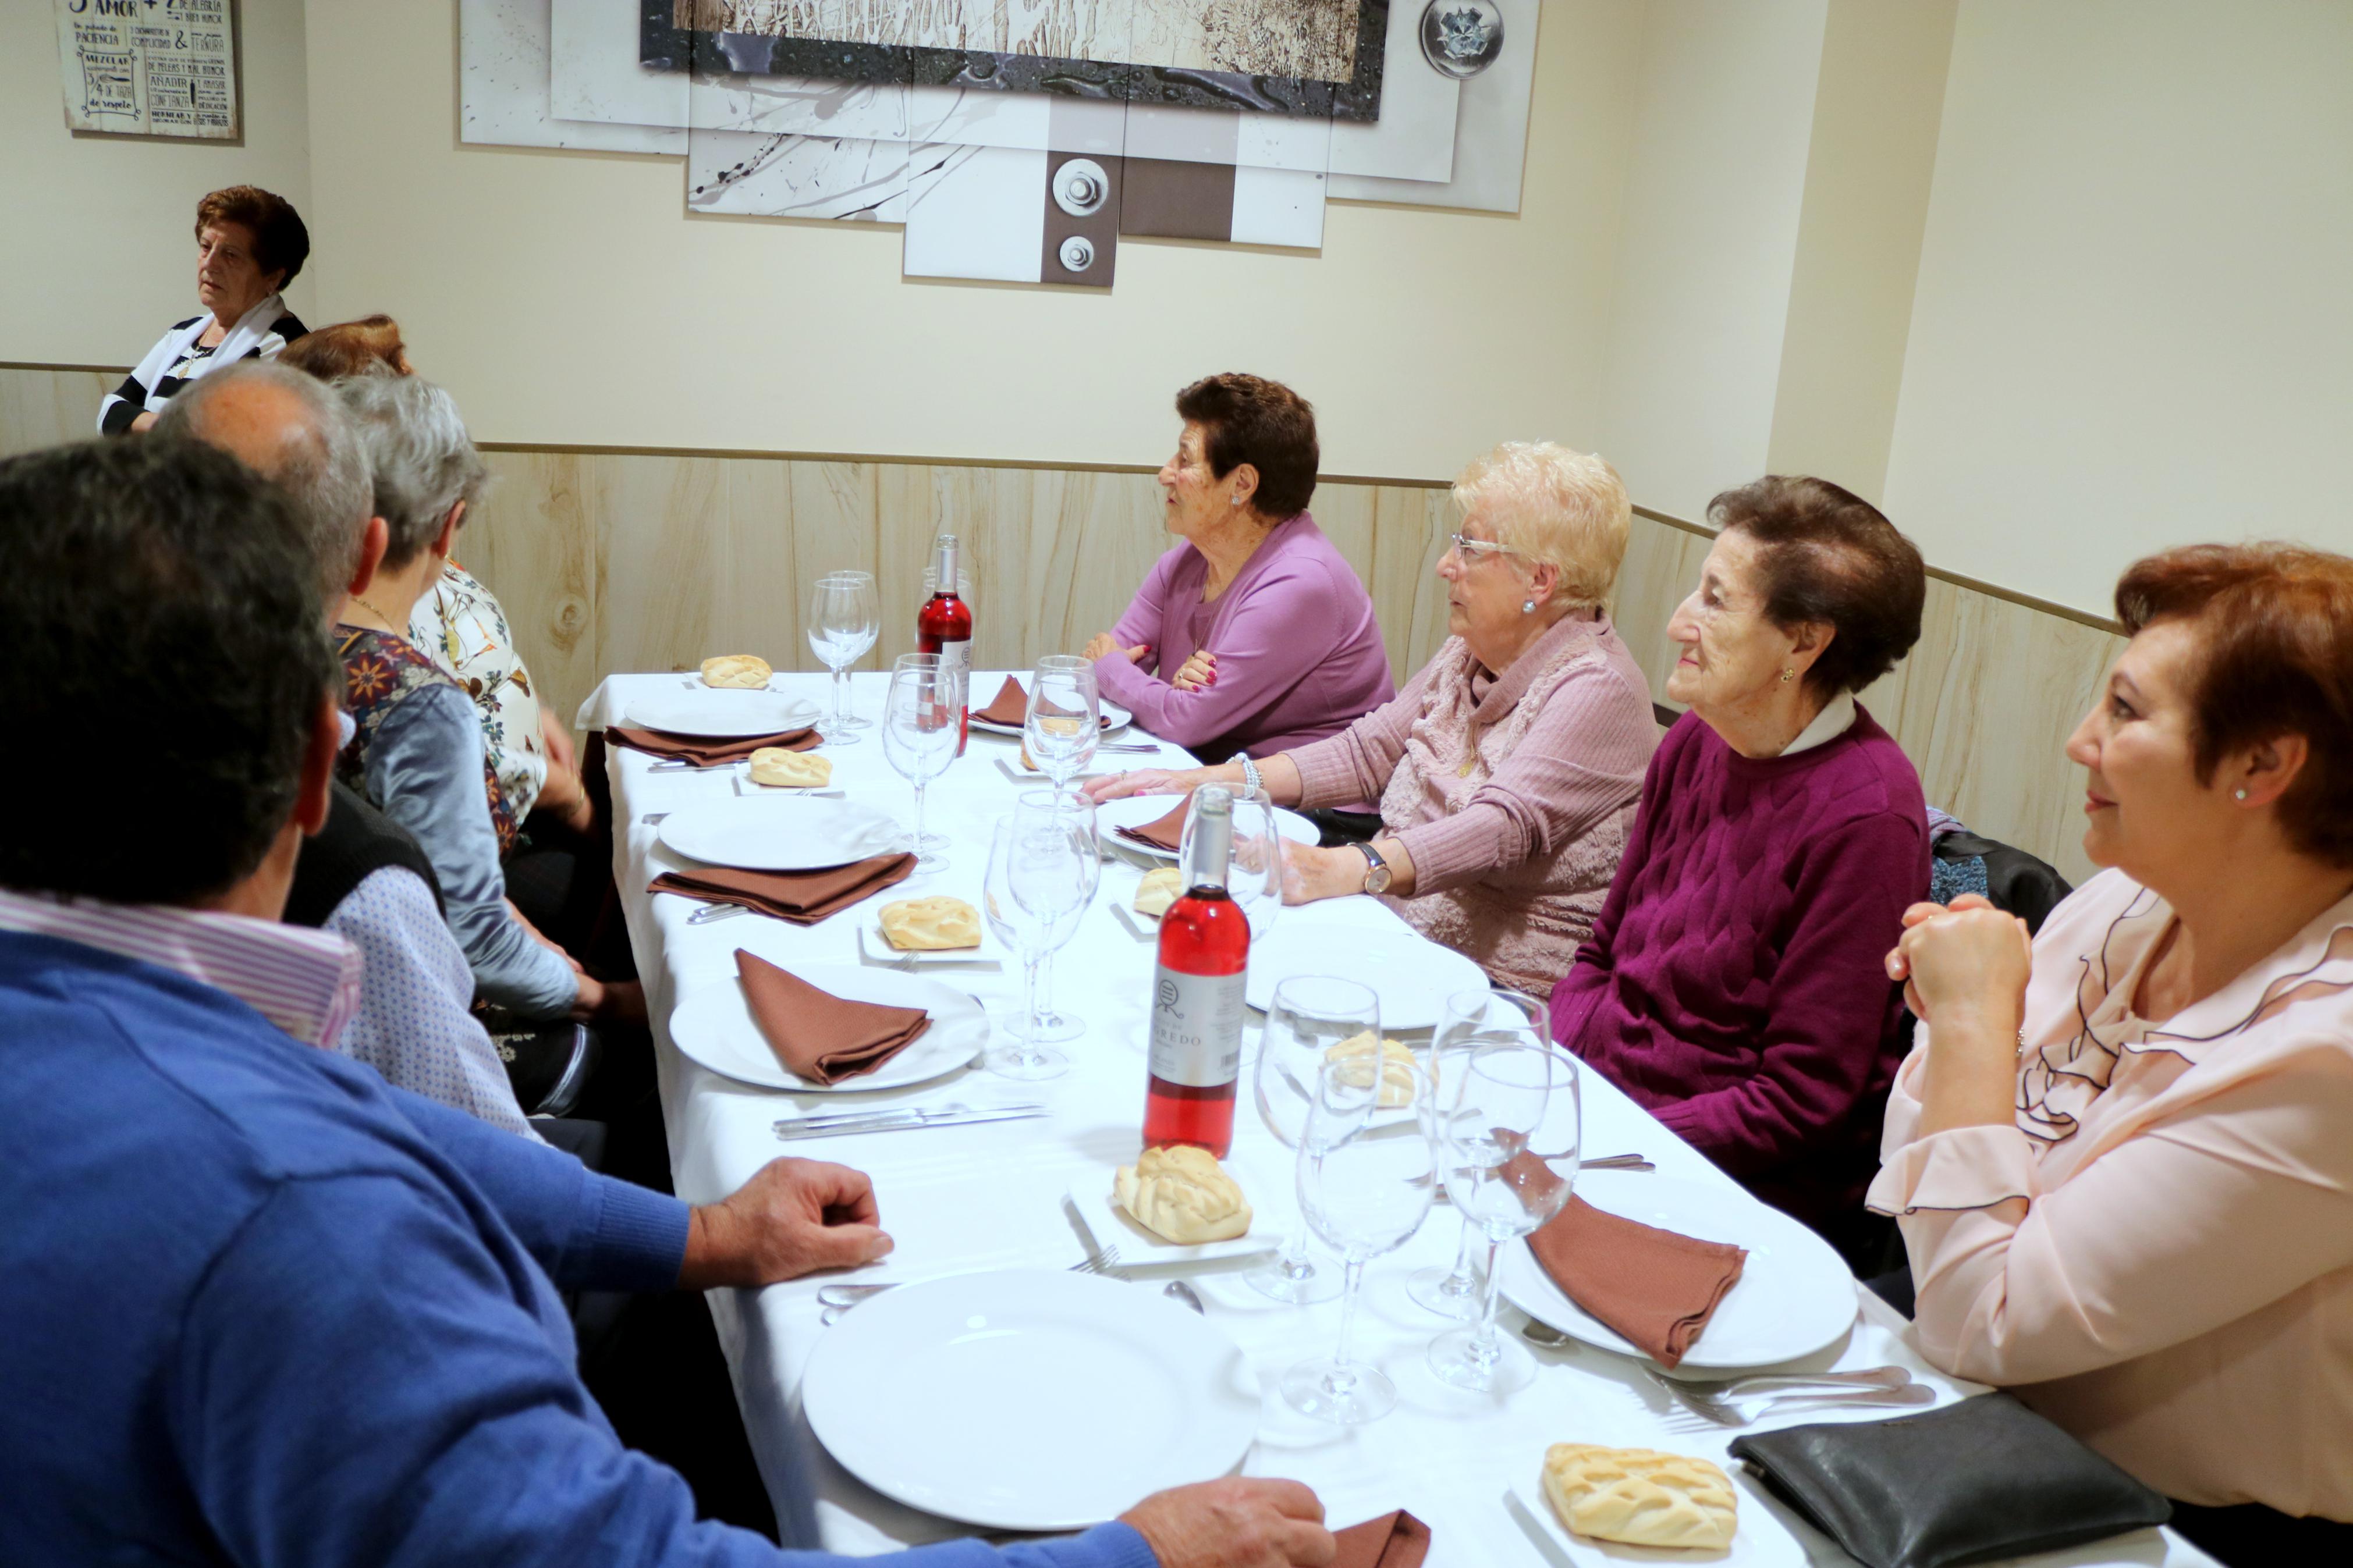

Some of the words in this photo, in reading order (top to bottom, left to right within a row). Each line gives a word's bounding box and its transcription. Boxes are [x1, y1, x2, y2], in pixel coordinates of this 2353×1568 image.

[75, 32, 119, 45] PACIENCIA
[191, 37, 225, 52] TERNURA
[86, 54, 130, 65] MEZCLAR
[158, 62, 180, 73] PELEAS
[203, 65, 226, 76] HUMOR
[150, 74, 188, 88] AÑADIR
[203, 79, 226, 89] AMASAR
[116, 85, 132, 98] TAZA
[90, 98, 99, 106] de
[102, 100, 132, 110] respeto
[151, 94, 190, 108] CONFIANZA
